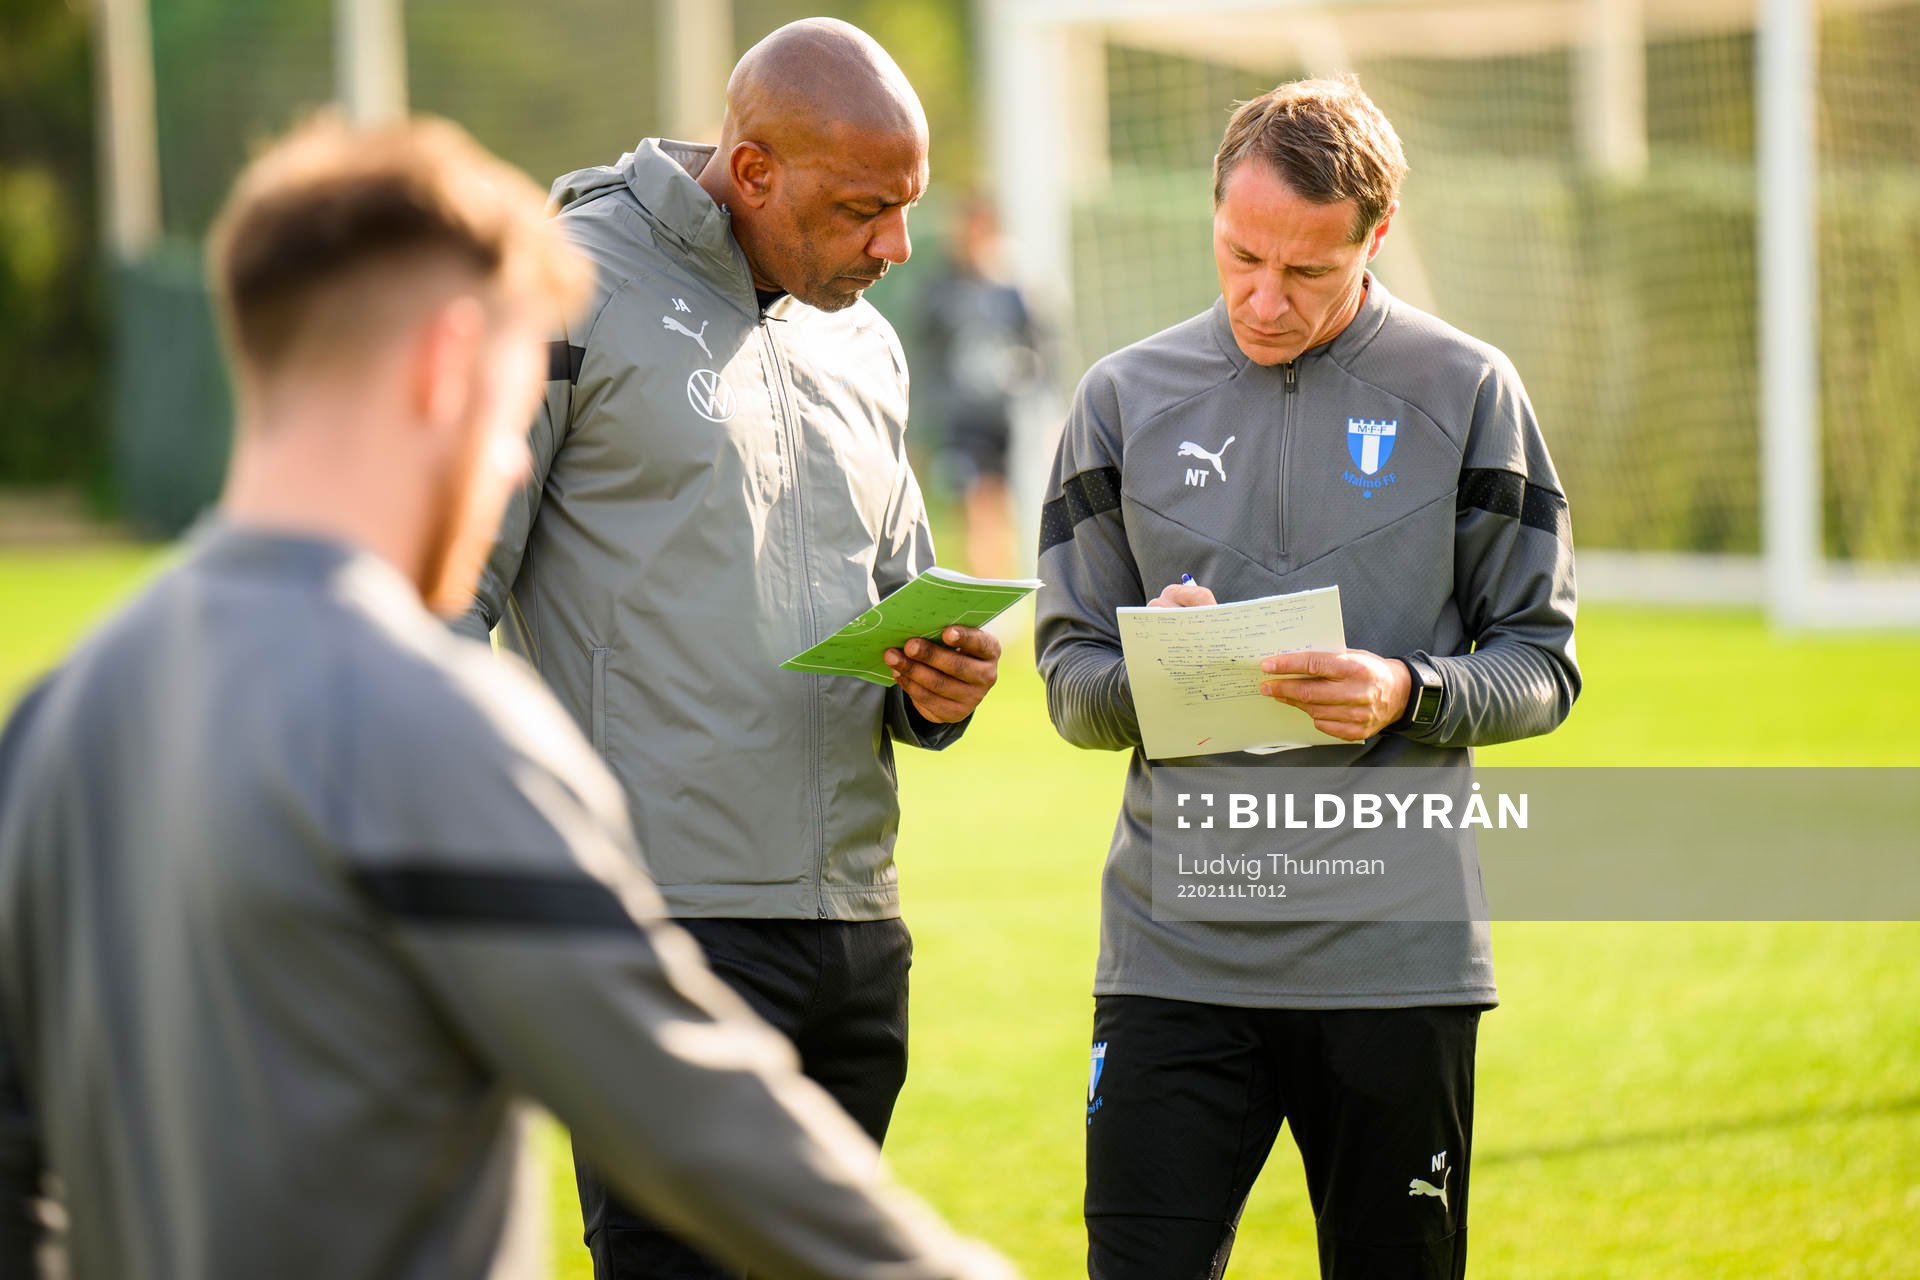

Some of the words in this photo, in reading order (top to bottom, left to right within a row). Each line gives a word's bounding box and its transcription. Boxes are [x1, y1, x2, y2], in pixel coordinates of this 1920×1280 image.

[672, 298, 691, 313] JA
[1184, 468, 1210, 487] NT
[1343, 470, 1382, 489] Malmö
[1383, 472, 1397, 486] FF
[1432, 1150, 1447, 1172] NT
